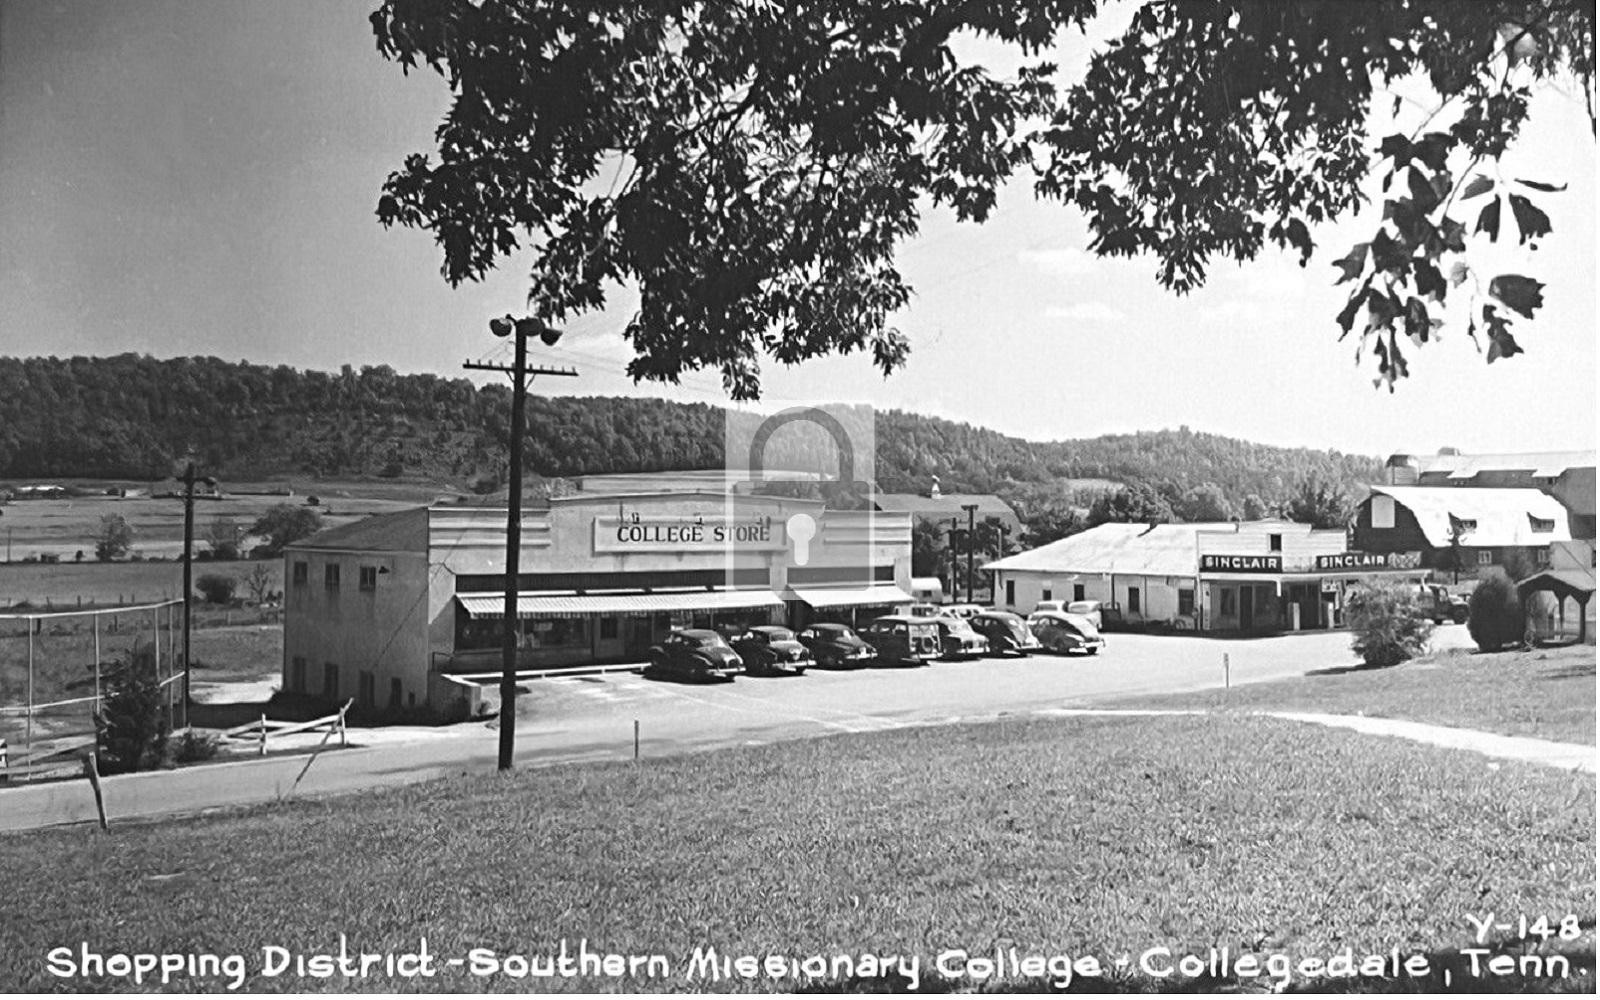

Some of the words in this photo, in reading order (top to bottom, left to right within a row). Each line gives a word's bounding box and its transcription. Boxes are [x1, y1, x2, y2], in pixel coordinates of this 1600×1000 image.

[617, 526, 704, 542] COLLEGE
[714, 526, 770, 542] STORE
[1205, 556, 1277, 568] SINCLAIR
[1320, 555, 1385, 568] SINCLAIR
